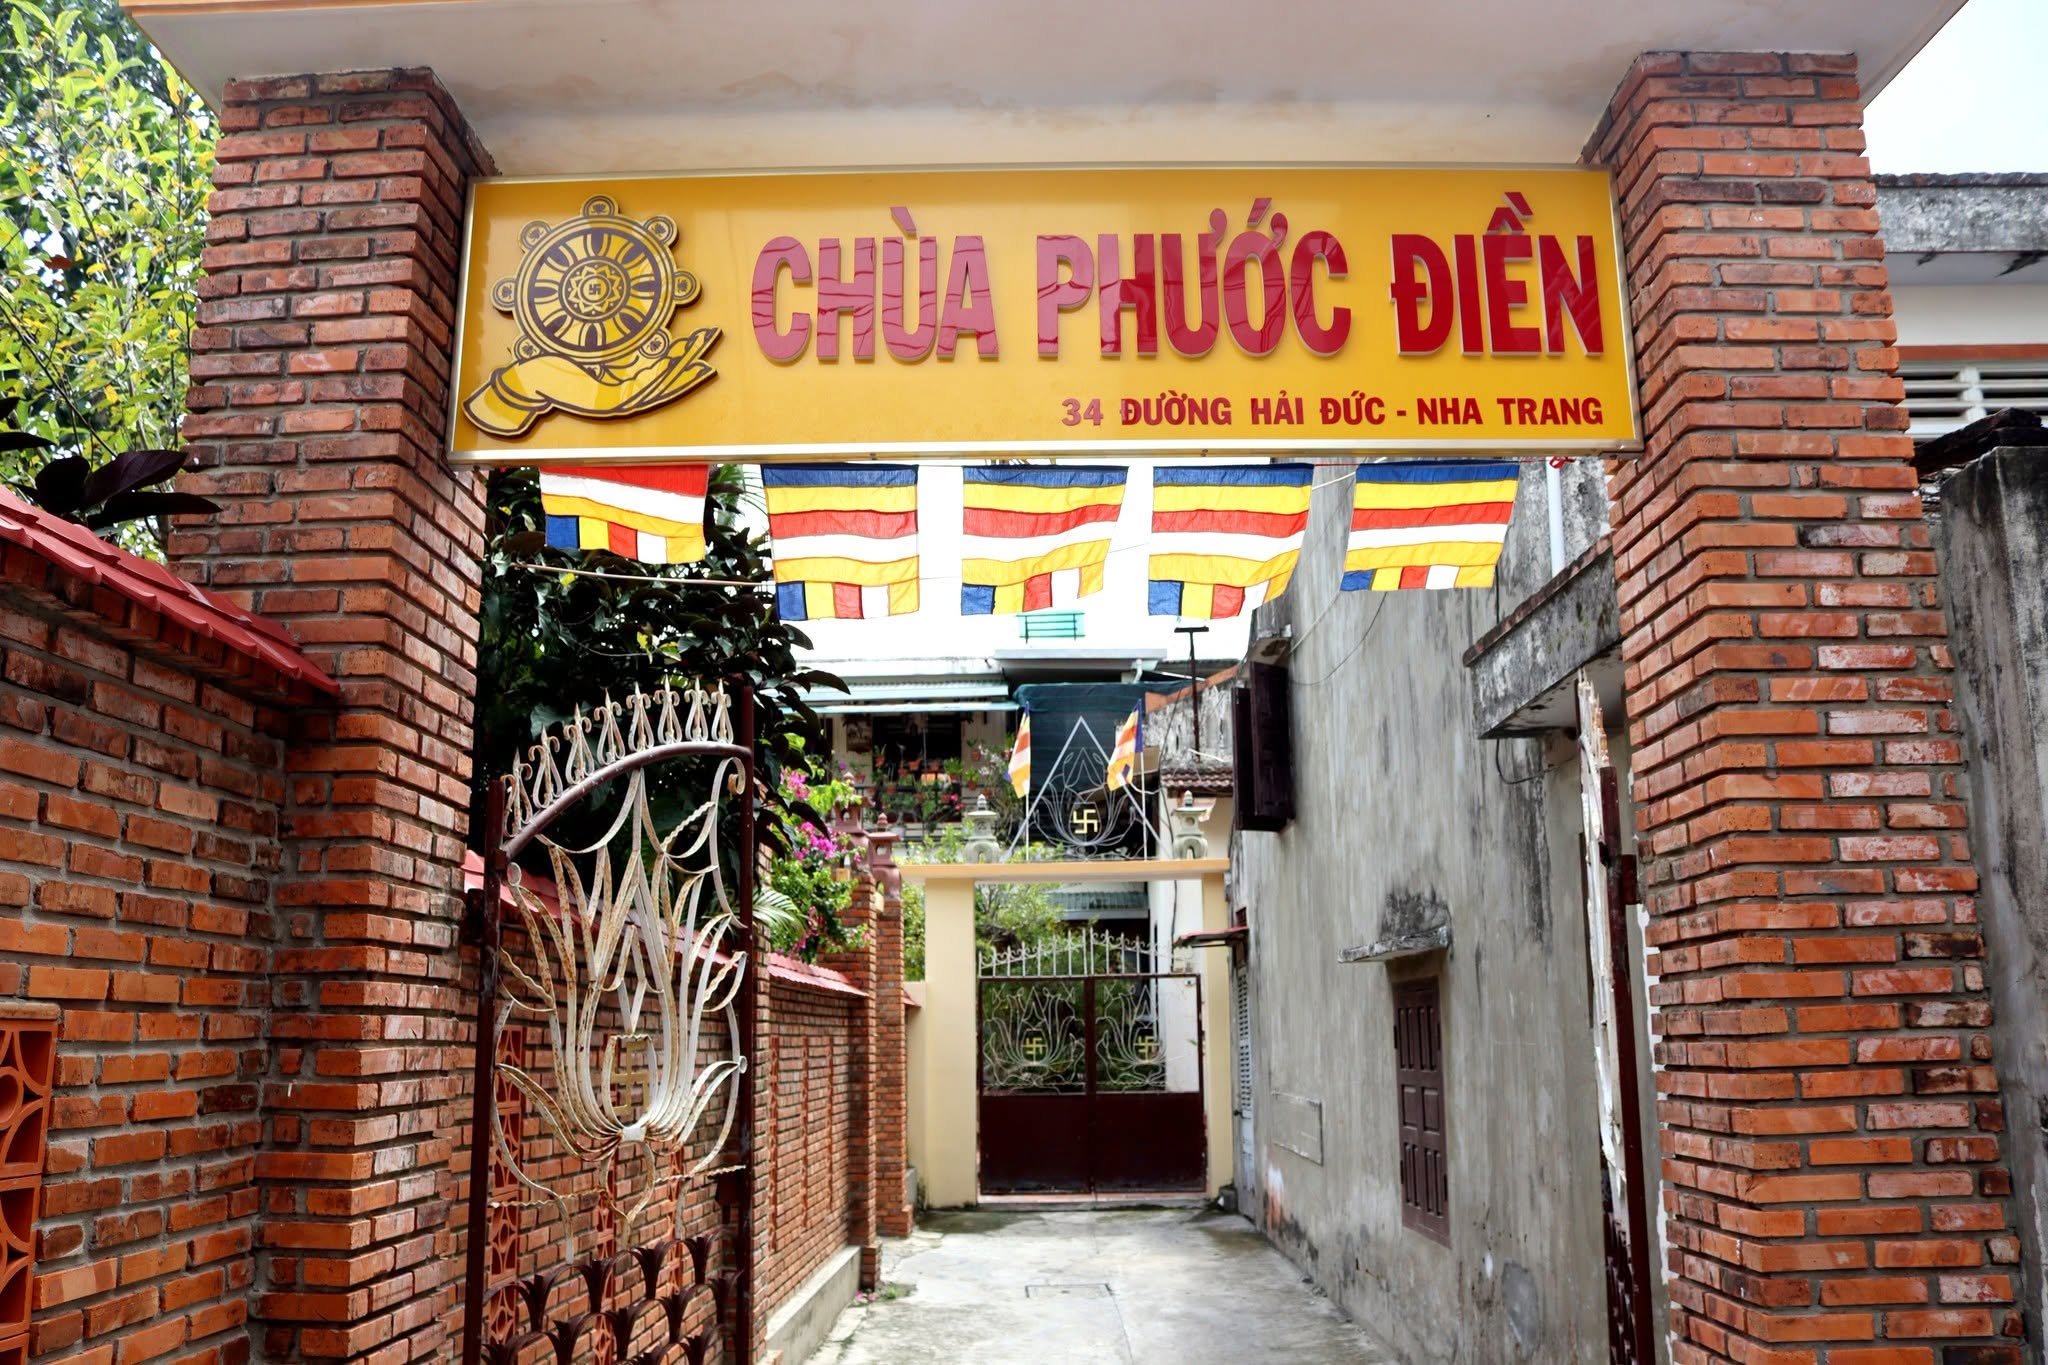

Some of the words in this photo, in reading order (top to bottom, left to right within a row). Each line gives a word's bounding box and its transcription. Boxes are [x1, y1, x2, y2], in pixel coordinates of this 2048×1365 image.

[751, 206, 1000, 361] CHÙA
[1036, 197, 1351, 358] PHƯỚC
[1389, 191, 1604, 356] ĐIỀN
[1061, 398, 1104, 426] 34
[1120, 390, 1232, 425] ĐƯỜNG
[1250, 390, 1304, 425] HẢI
[1319, 390, 1386, 425] ĐỨC
[1417, 397, 1483, 425] NHA
[1497, 397, 1604, 425] TRANG
